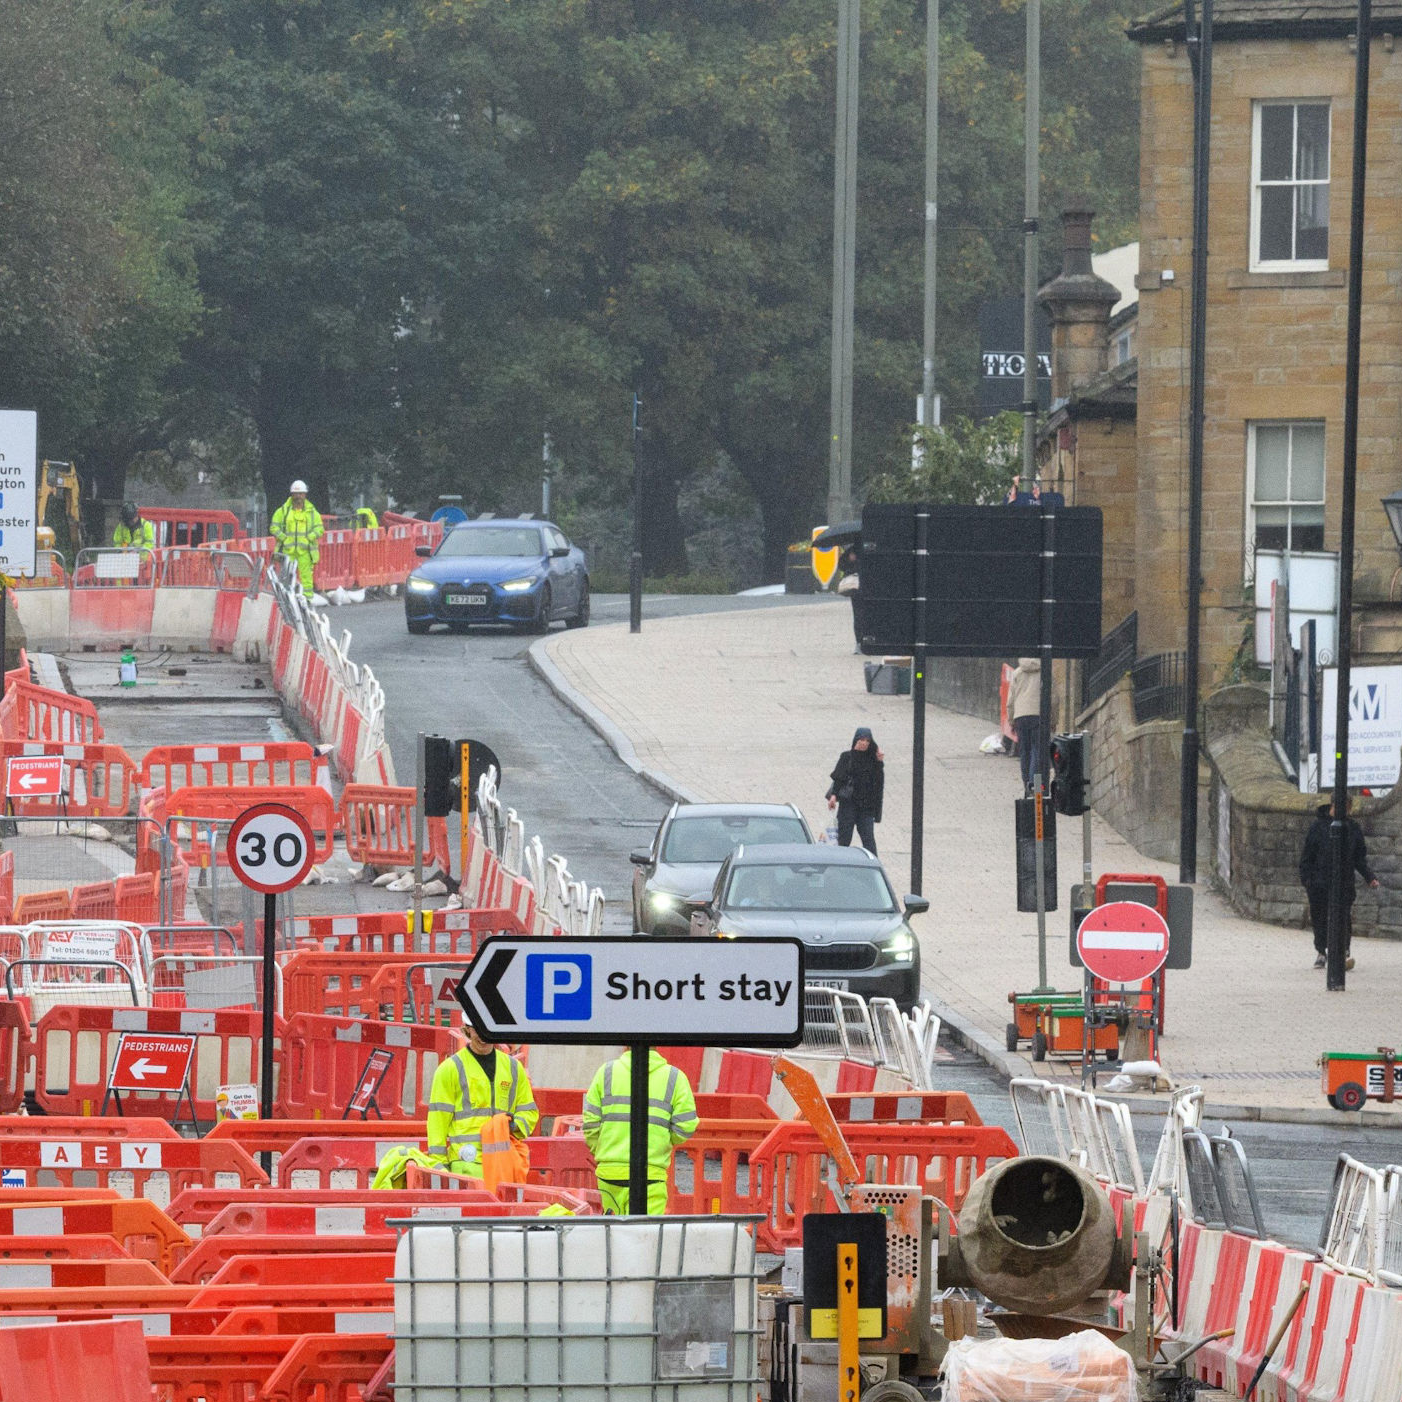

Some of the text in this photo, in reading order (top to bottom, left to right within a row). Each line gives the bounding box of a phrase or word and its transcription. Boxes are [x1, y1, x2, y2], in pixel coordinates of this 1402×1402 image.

[11, 762, 59, 771] PEDESTRIANS
[240, 831, 302, 868] 30
[542, 961, 792, 1014] P Short stay
[124, 1041, 189, 1053] PEDESTRIANS
